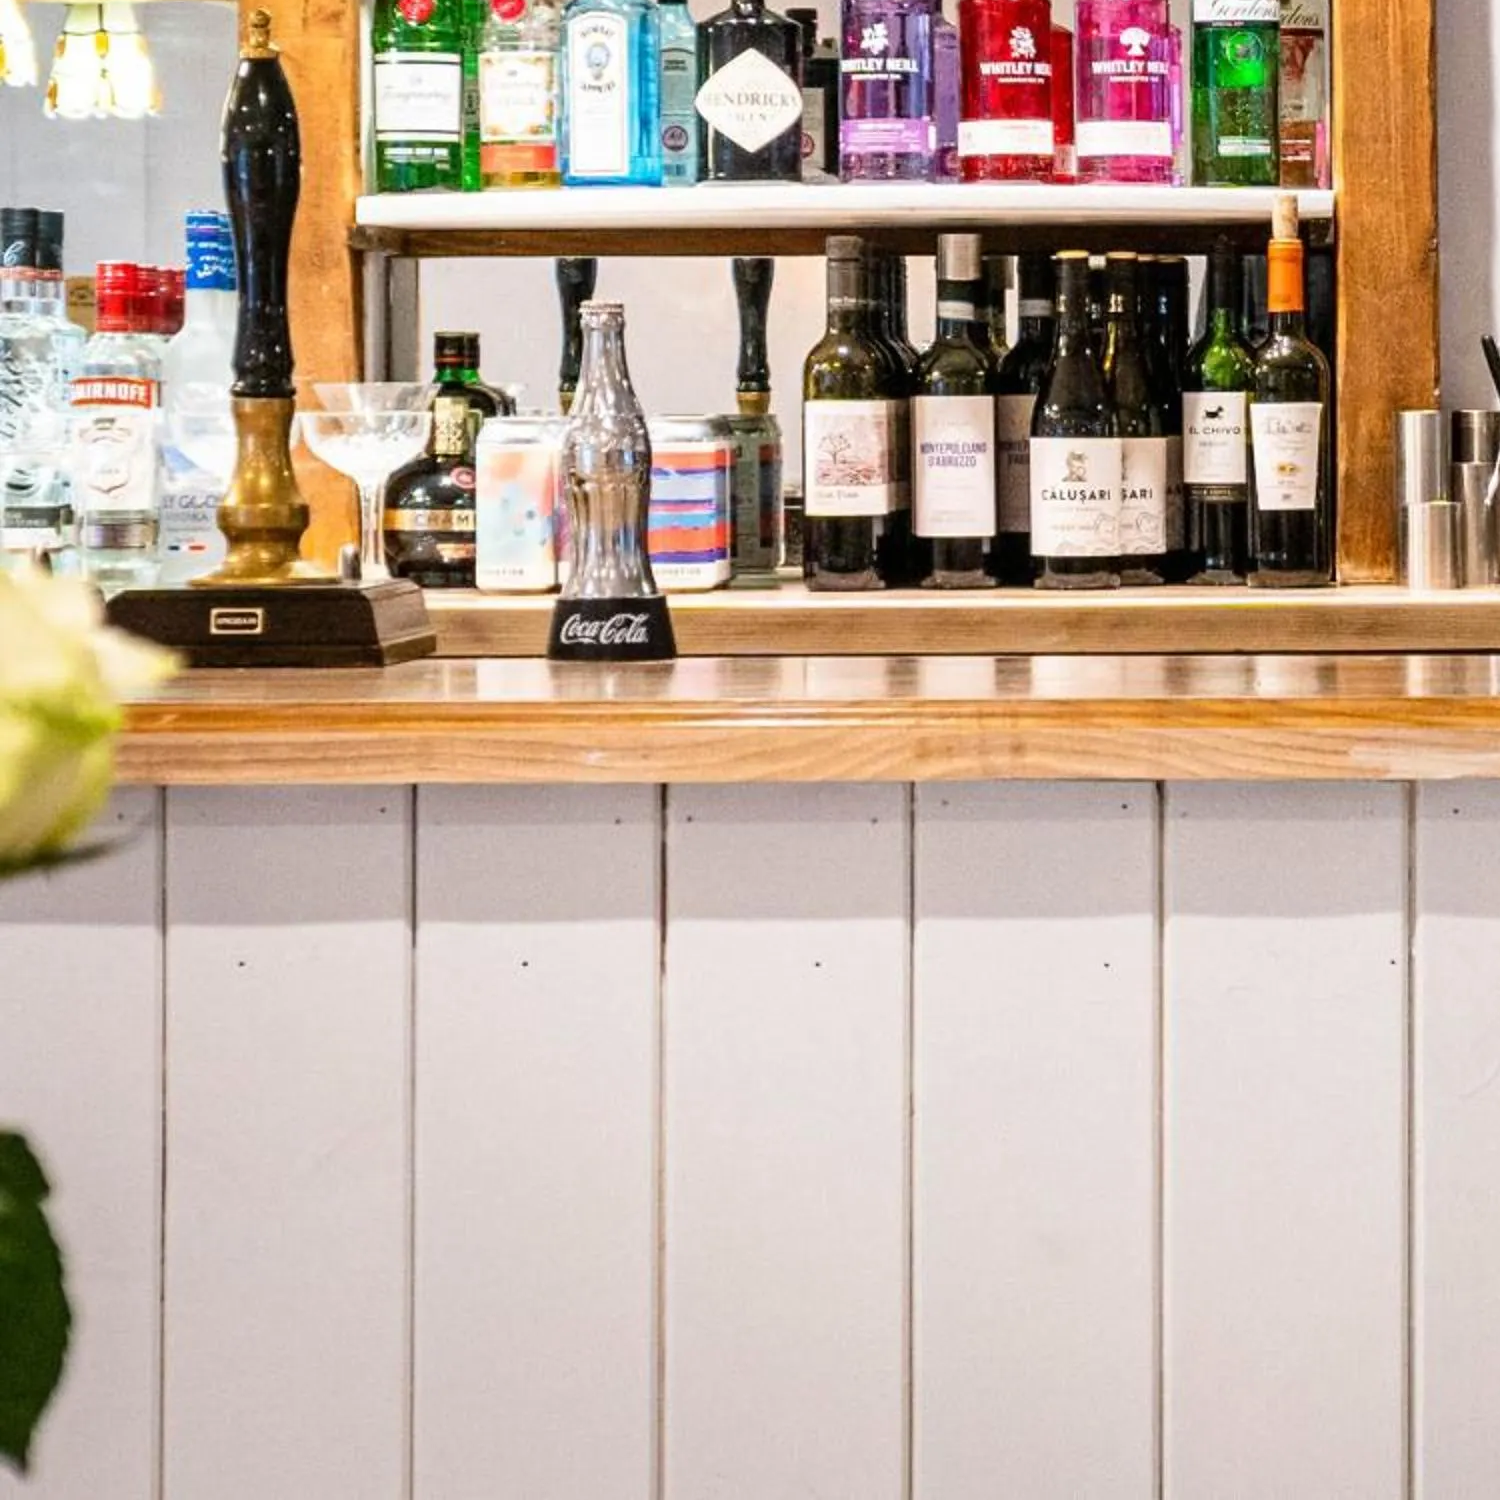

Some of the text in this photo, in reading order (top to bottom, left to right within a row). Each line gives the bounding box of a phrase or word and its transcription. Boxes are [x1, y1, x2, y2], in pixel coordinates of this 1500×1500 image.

[979, 61, 1033, 75] WHITLEY
[1091, 60, 1145, 75] WHITLEY
[560, 613, 650, 645] Coca-Cola
